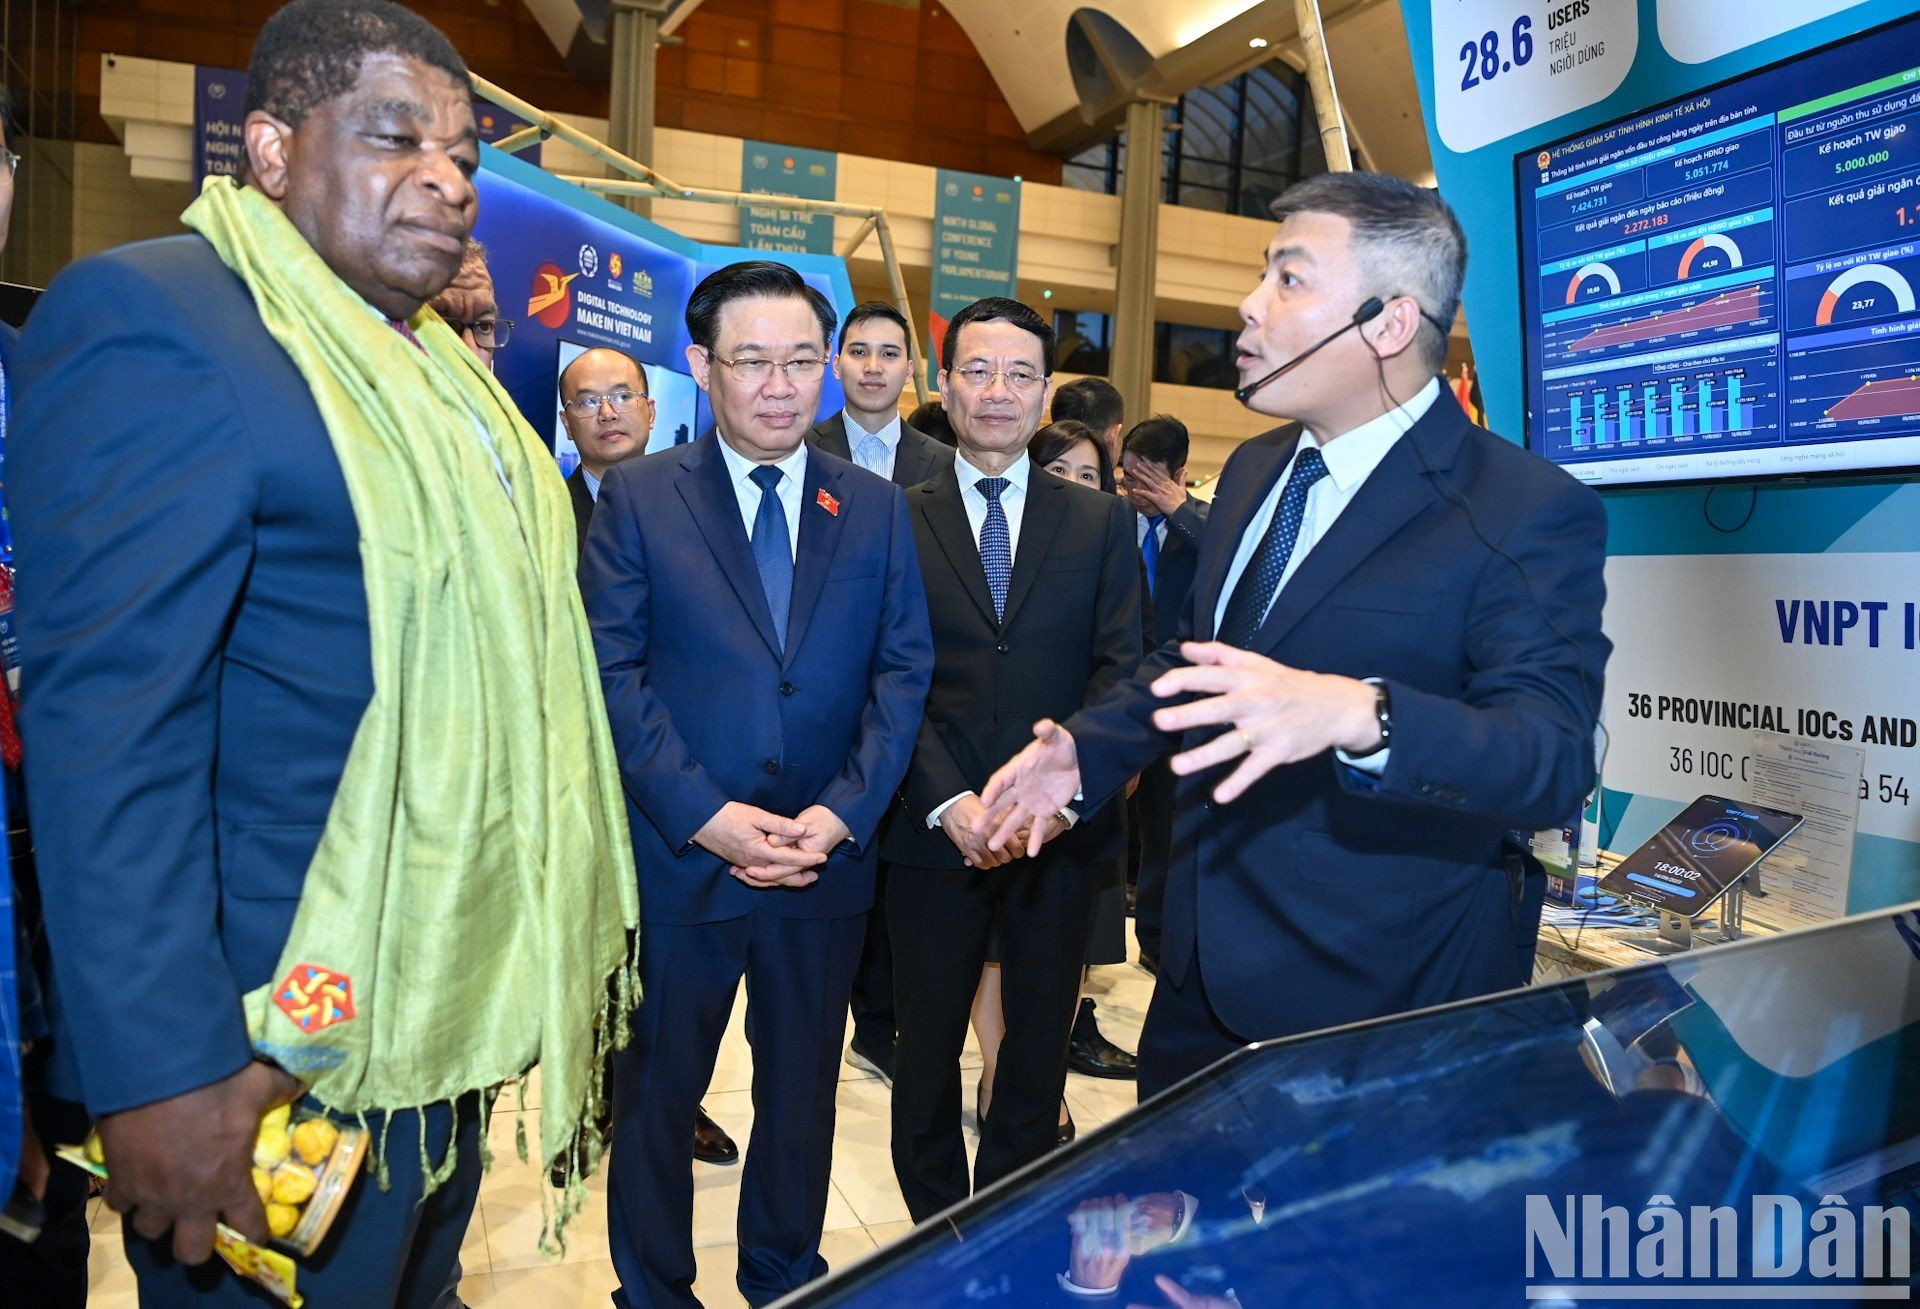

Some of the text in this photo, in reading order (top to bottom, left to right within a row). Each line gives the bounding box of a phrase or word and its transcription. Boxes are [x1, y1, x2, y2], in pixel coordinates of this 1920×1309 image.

[1548, 0, 1590, 30] USERS
[1459, 14, 1533, 92] 28.6
[1549, 31, 1577, 55] TRIỆU
[1578, 41, 1605, 66] DÙNG
[1855, 110, 1870, 120] thu
[1725, 143, 1740, 155] giao
[1833, 135, 1862, 151] hoạch
[1864, 128, 1881, 142] TW
[1883, 123, 1906, 140] giao
[1685, 159, 1729, 181] 5.051.774
[1835, 150, 1890, 174] 5.000.000
[1887, 177, 1914, 194] ngân
[1571, 195, 1608, 214] 7.424.731
[1624, 214, 1669, 235] 2.272.183
[1882, 248, 1899, 260] giao
[577, 290, 652, 325] DIGITAL TECHNOLOGY
[1852, 298, 1875, 310] 23,77
[577, 307, 603, 329] MAKE
[603, 315, 613, 332] IN
[614, 319, 632, 337] VIET
[632, 325, 652, 344] NAM
[1775, 599, 1920, 650] VNPT I
[1628, 693, 1917, 748] 36 PROVINCIAL IOCs AND
[1669, 746, 1693, 774] 36
[1700, 750, 1733, 780] IOC
[1878, 774, 1910, 806] 54
[1654, 861, 1701, 881] 18:00:02
